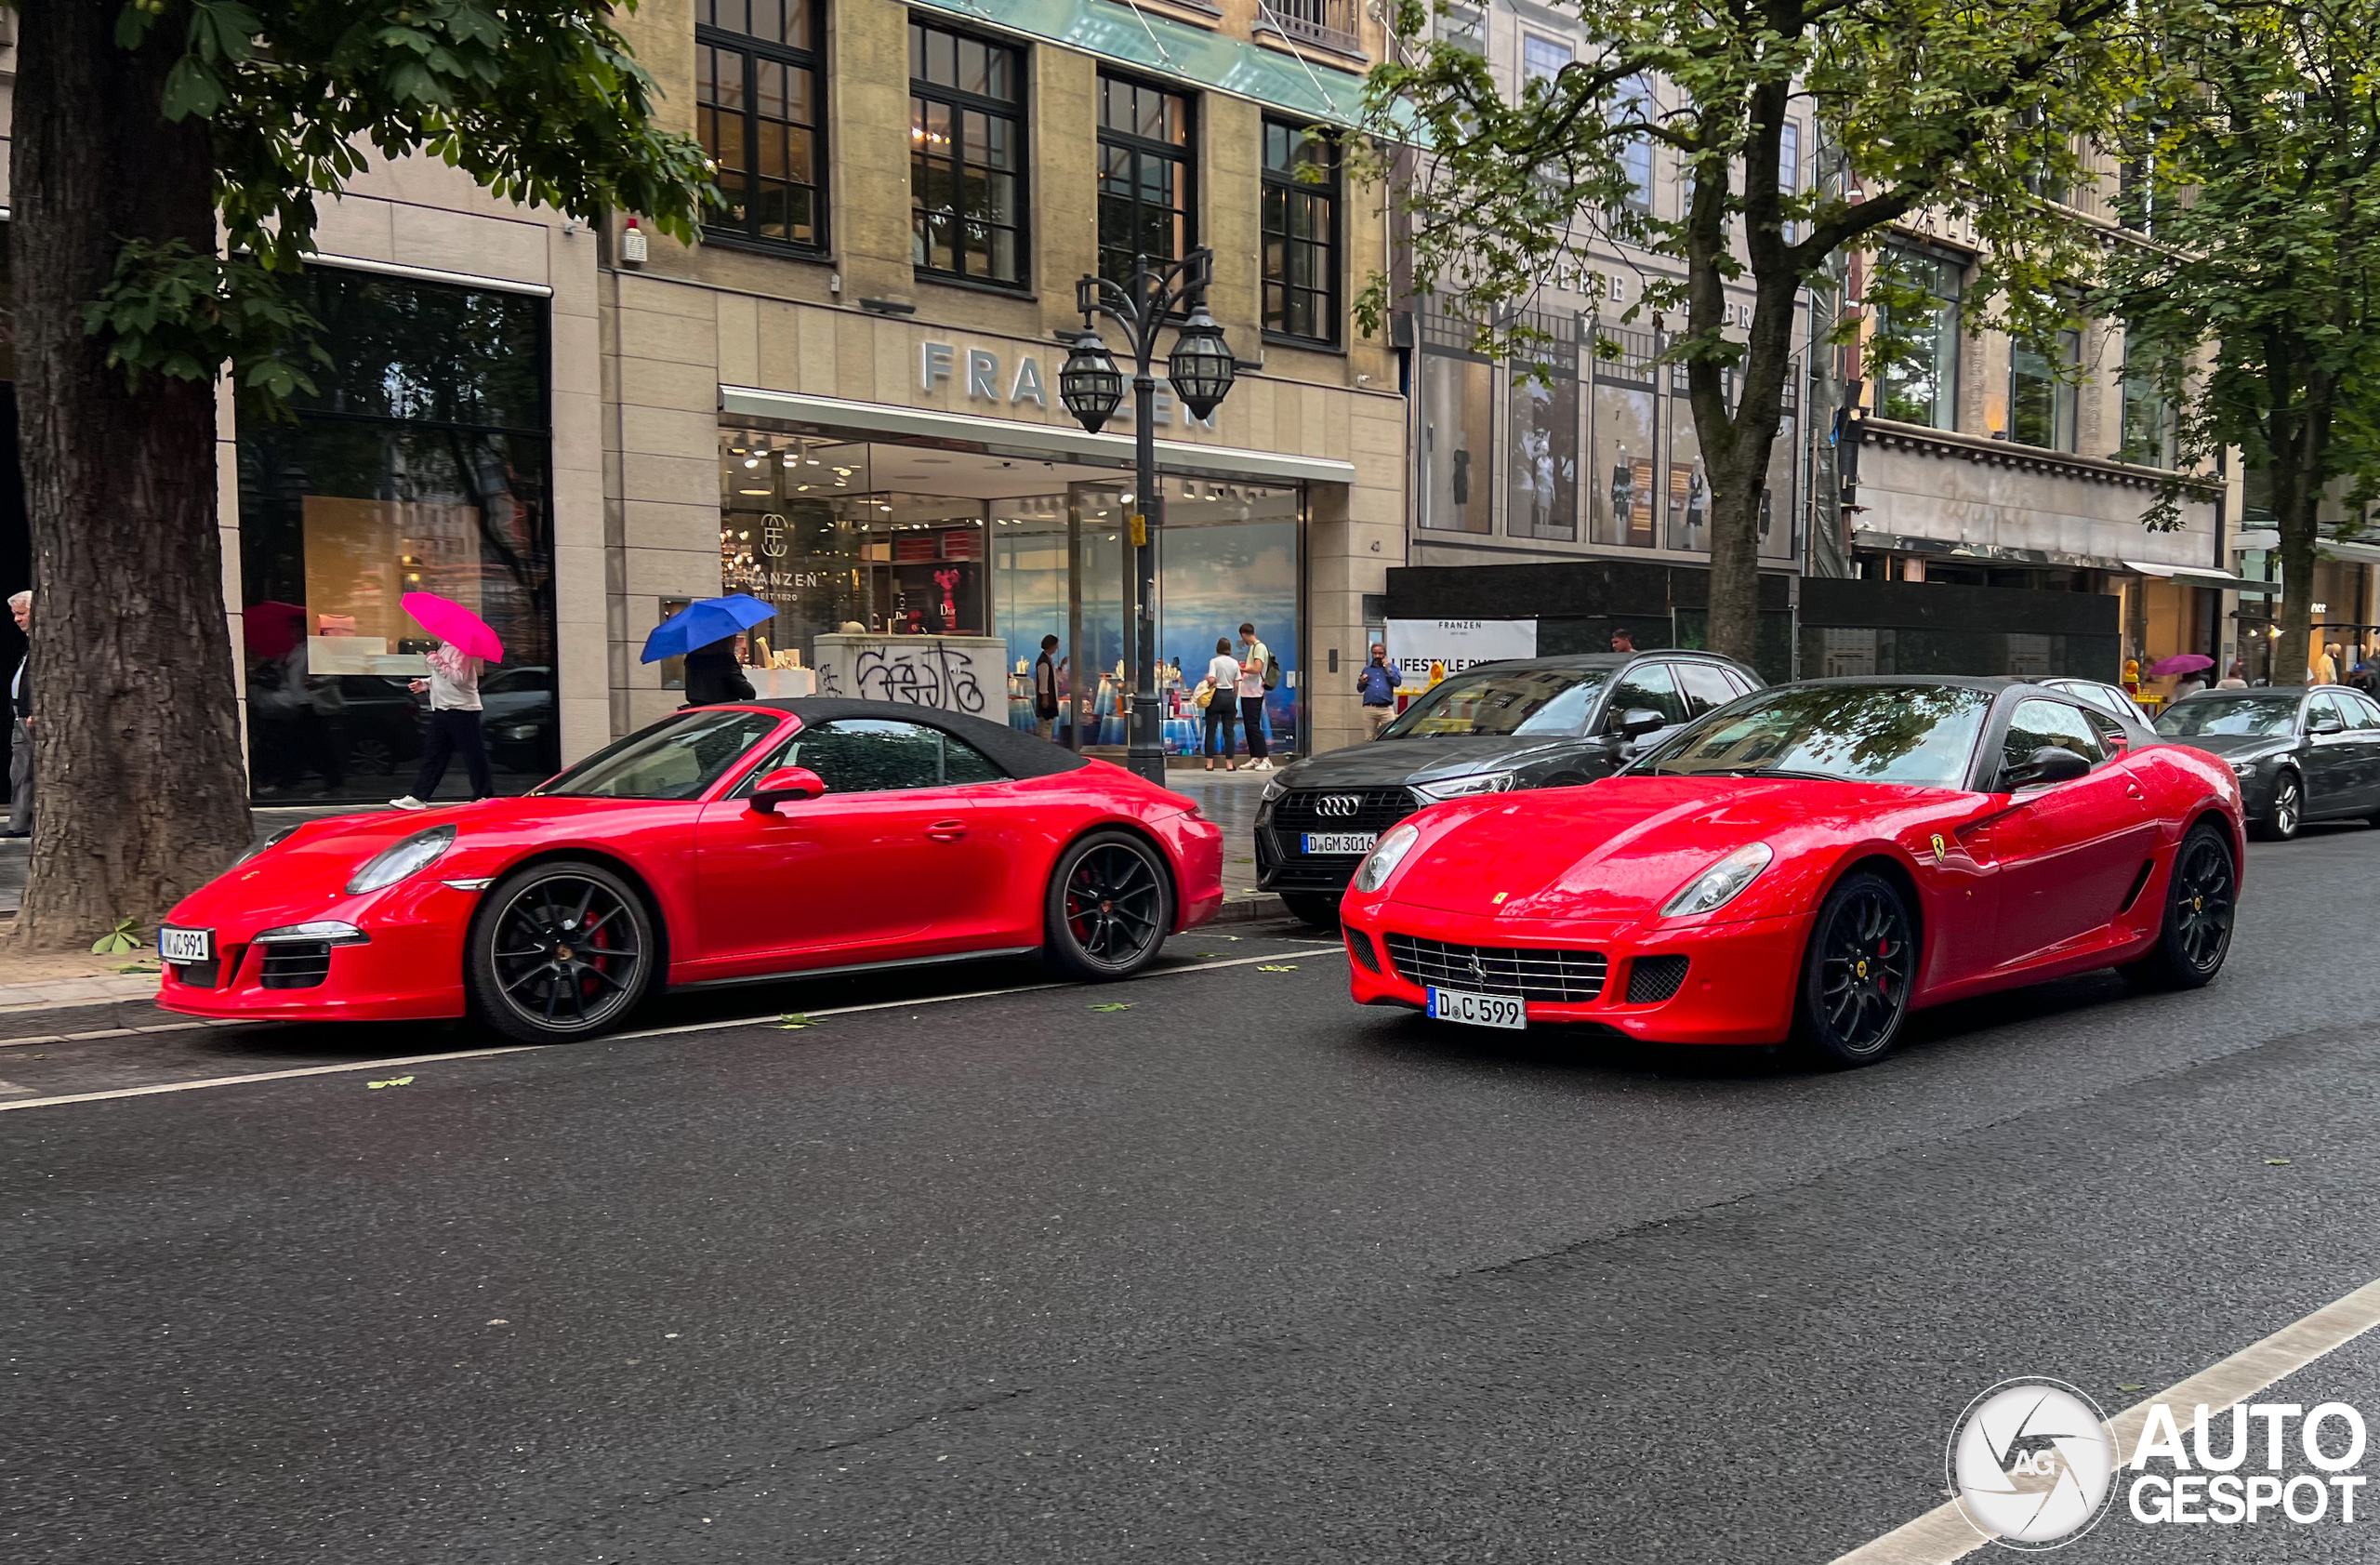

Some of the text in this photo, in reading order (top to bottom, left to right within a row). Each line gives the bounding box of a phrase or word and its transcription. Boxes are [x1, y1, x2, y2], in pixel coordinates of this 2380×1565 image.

[741, 571, 817, 587] RANZEN
[754, 592, 775, 601] SEIT
[1438, 621, 1482, 630] FRANZEN
[1309, 836, 1374, 851] D GM 3016
[183, 934, 205, 957] 991
[1439, 992, 1519, 1025] D C 599
